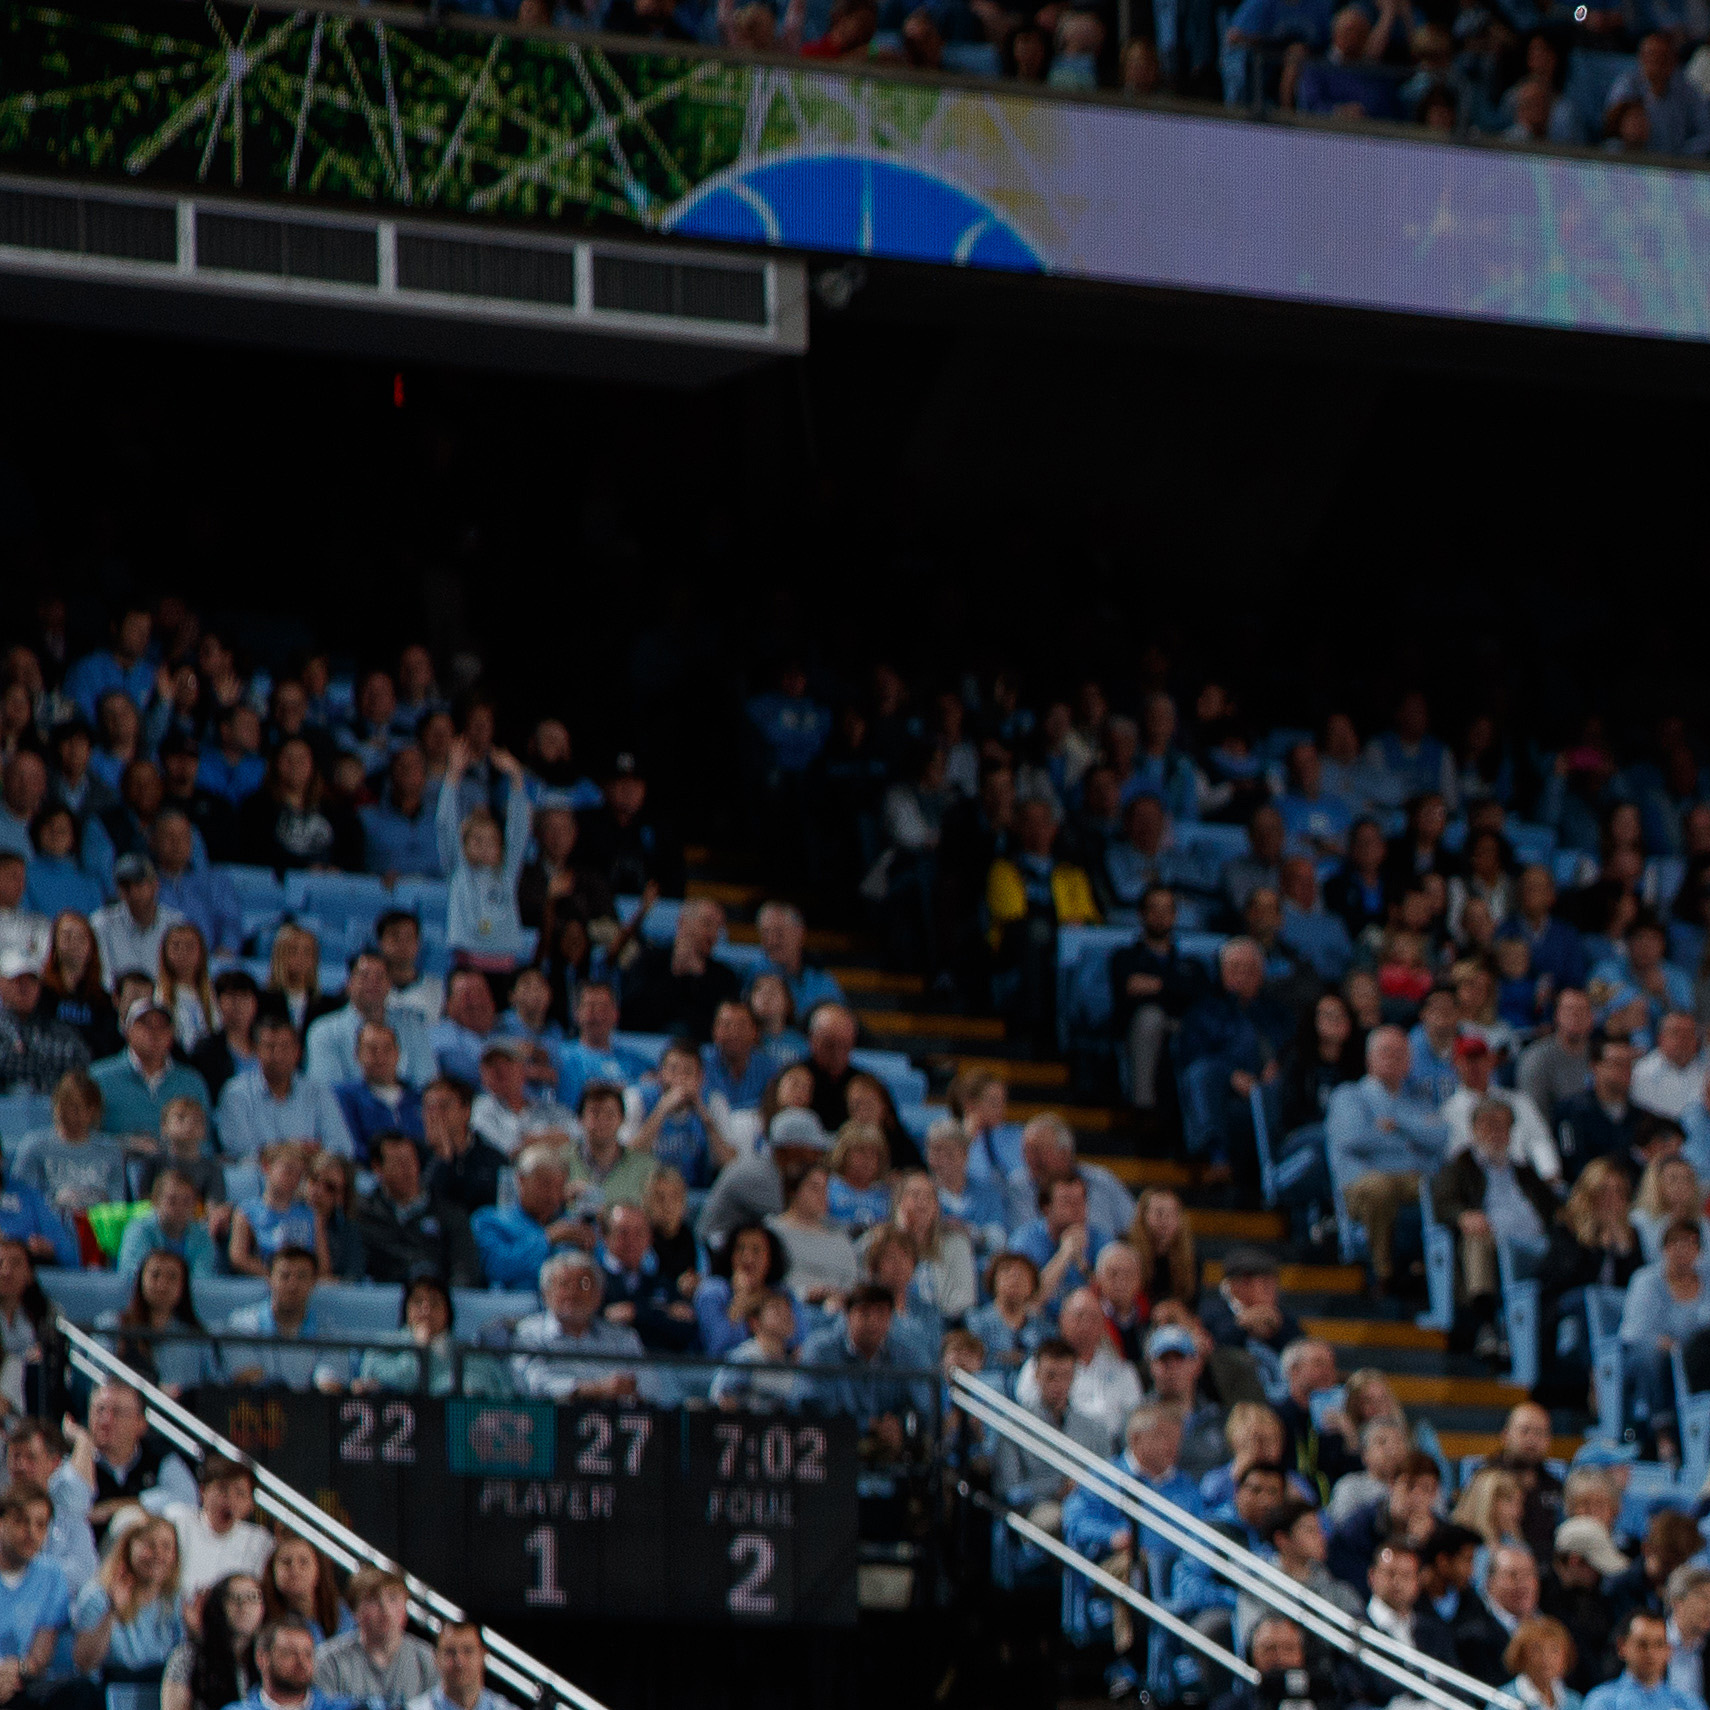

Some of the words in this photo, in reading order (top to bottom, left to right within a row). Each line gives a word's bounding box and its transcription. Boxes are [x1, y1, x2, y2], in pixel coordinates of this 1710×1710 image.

[338, 1400, 417, 1463] 22
[575, 1413, 653, 1476] 27
[713, 1422, 828, 1484] 7:02
[525, 1525, 567, 1607] 1
[726, 1532, 777, 1614] 2
